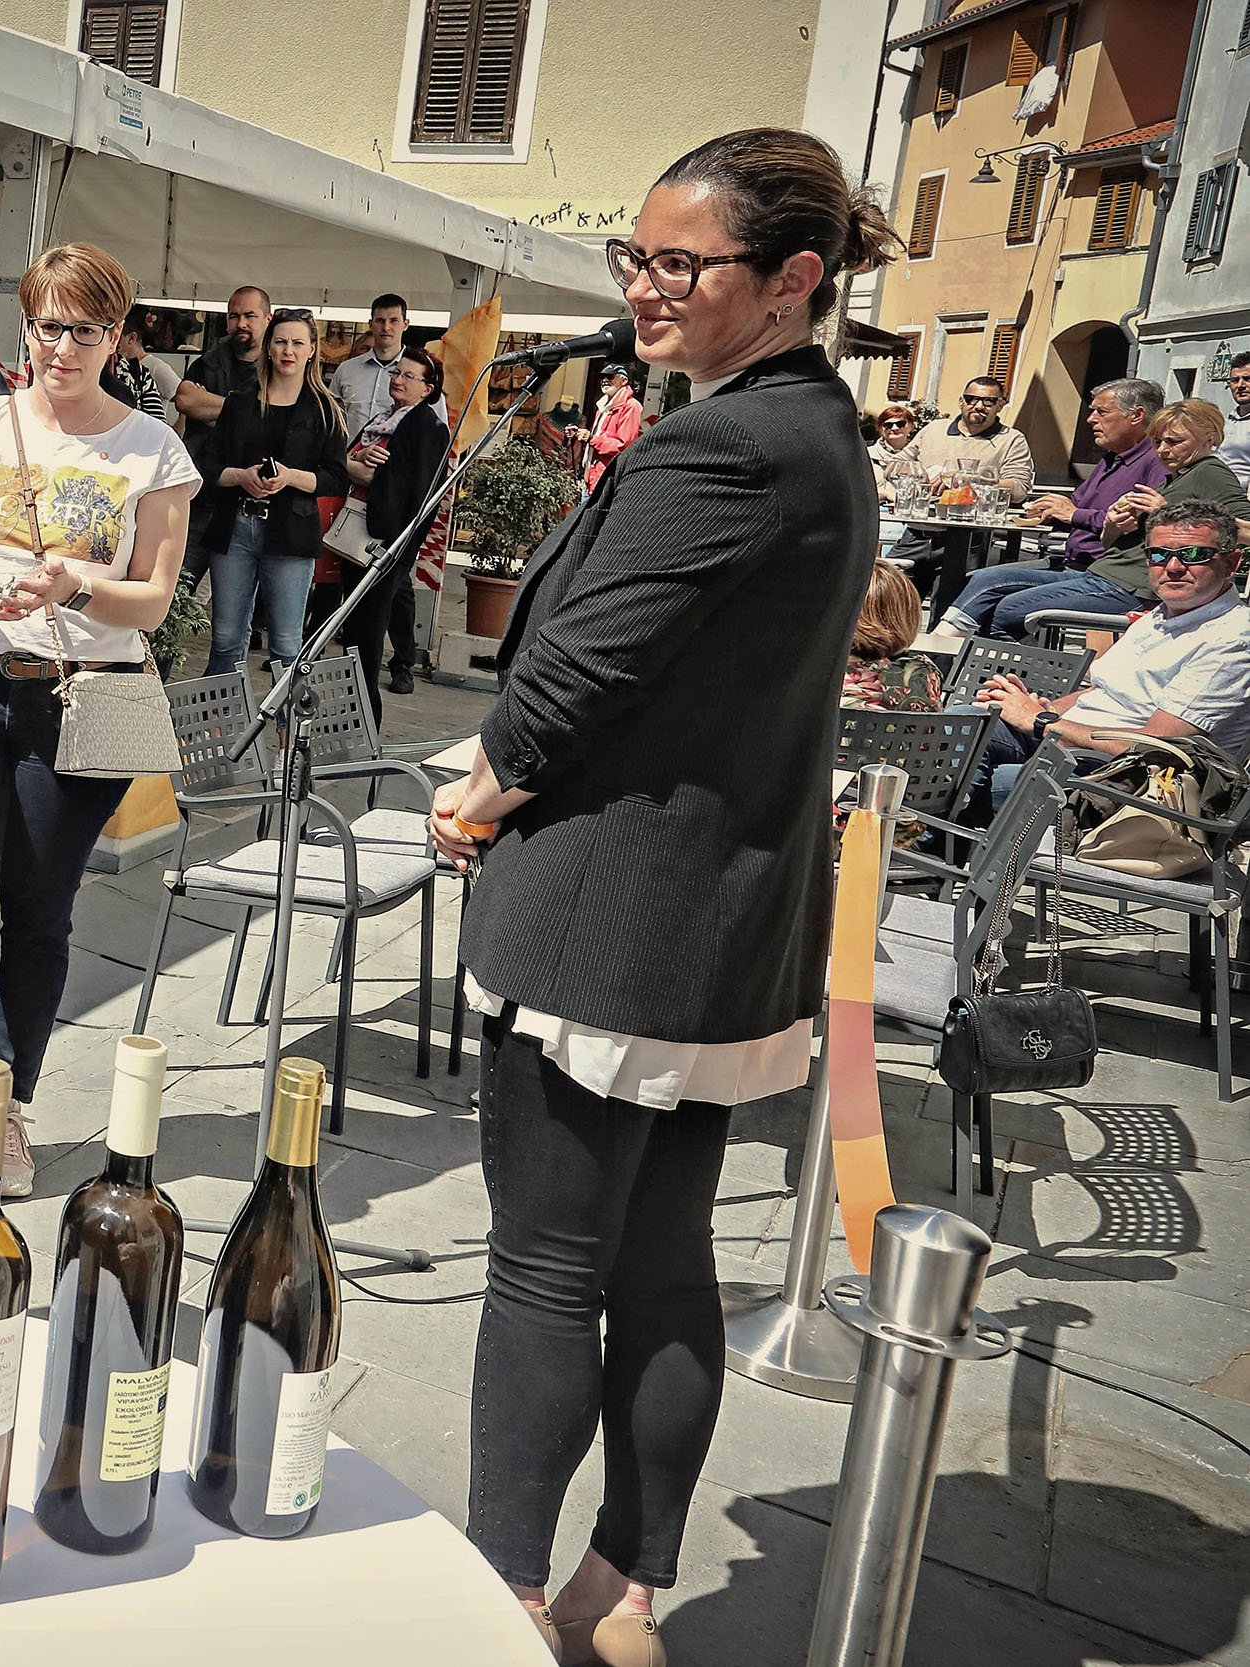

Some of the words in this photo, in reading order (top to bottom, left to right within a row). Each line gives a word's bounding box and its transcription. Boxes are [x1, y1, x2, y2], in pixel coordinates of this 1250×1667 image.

[528, 201, 574, 228] Craft
[576, 212, 592, 228] &
[596, 205, 628, 229] Art
